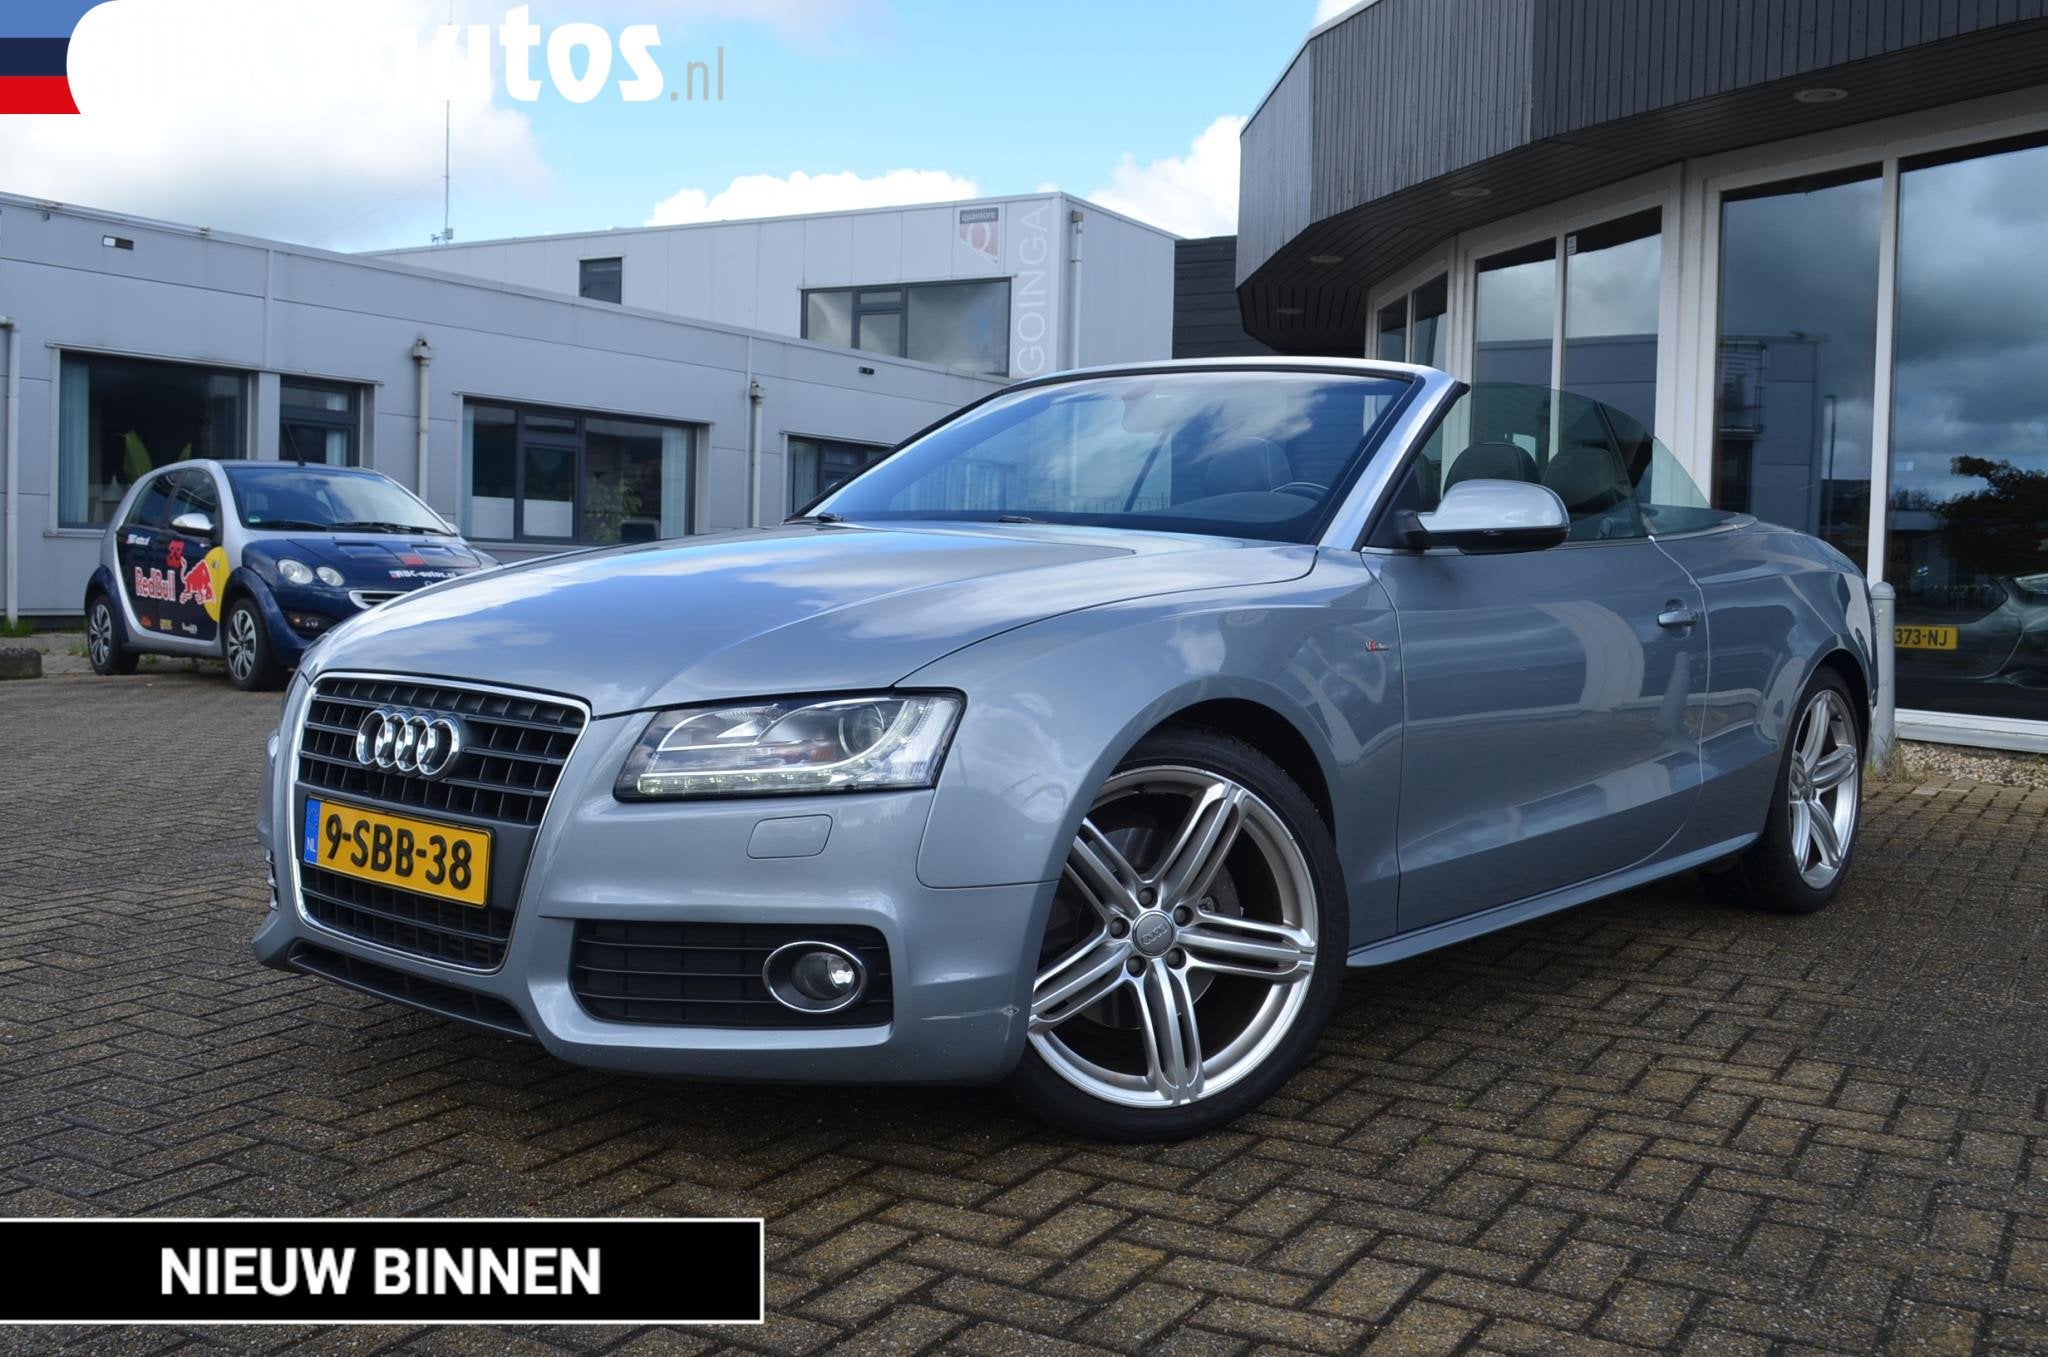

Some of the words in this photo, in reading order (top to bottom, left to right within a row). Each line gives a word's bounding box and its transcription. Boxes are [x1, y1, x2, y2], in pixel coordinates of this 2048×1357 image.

[1017, 205, 1049, 375] GOINGA
[306, 838, 316, 853] NL
[325, 813, 472, 890] 9-SBB-38
